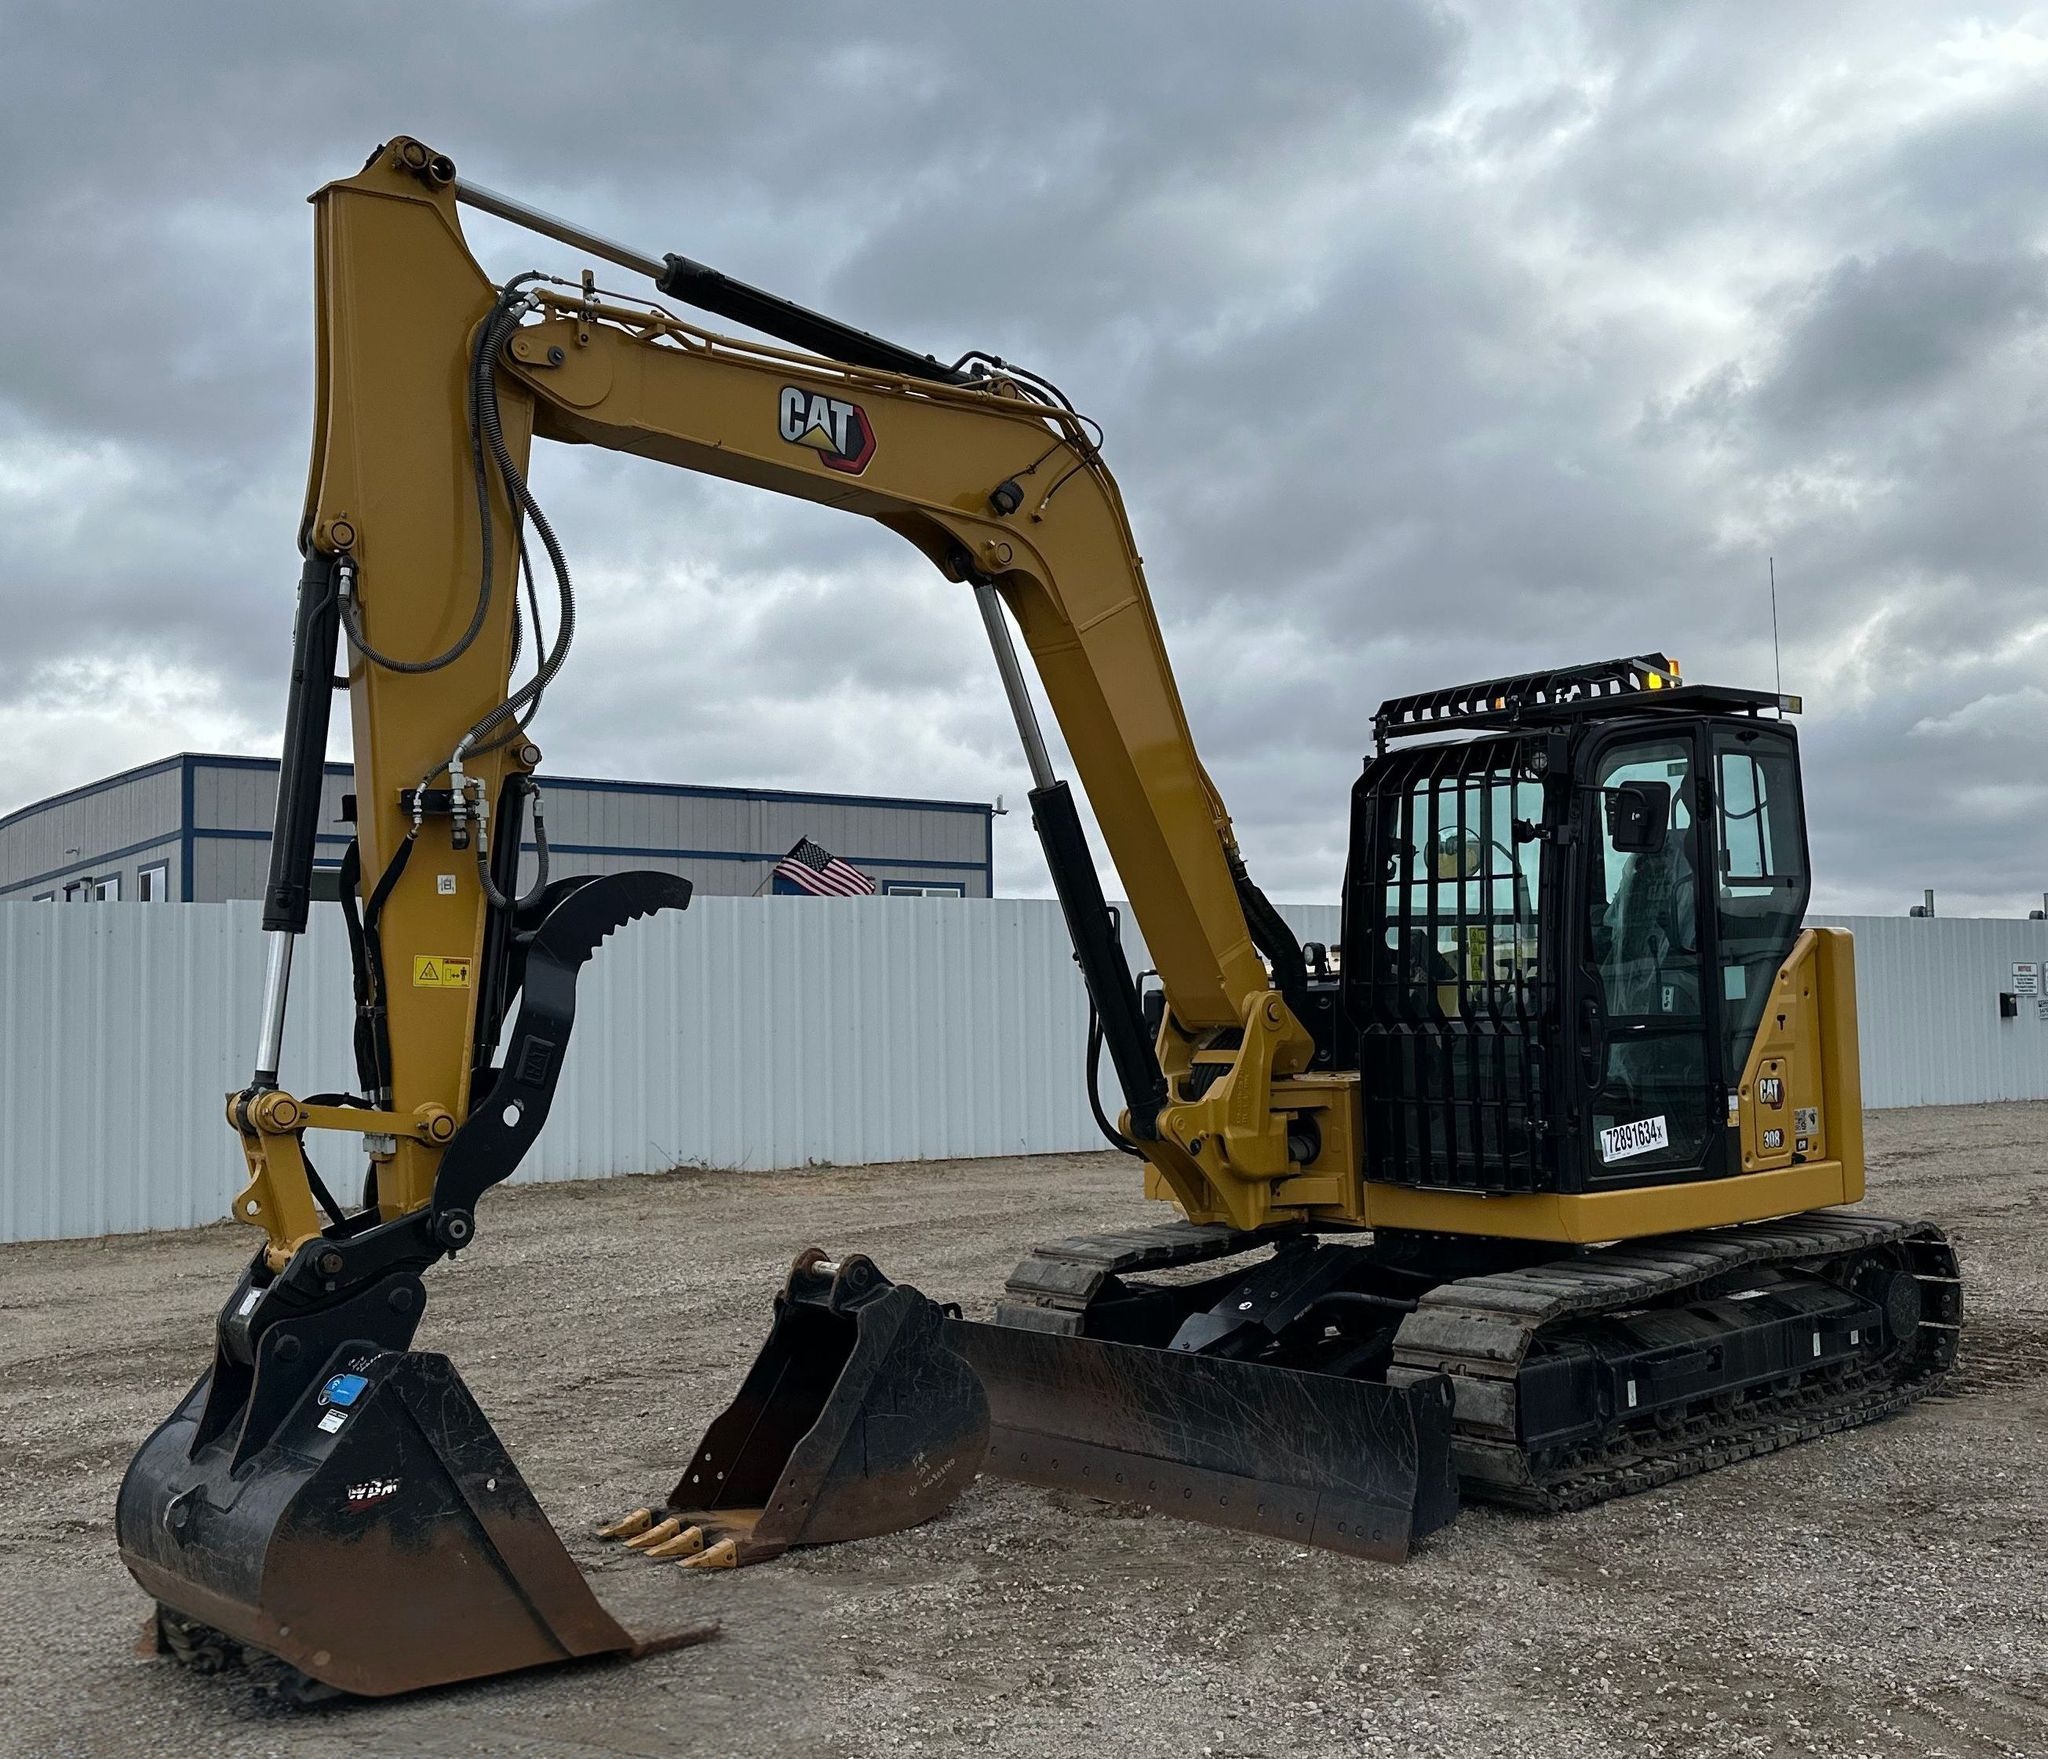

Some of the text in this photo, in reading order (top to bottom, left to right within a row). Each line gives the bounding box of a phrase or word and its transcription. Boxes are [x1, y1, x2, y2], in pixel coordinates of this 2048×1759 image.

[781, 387, 853, 455] CAT
[1760, 1079, 1779, 1103] CAT
[1763, 1130, 1780, 1148] 308
